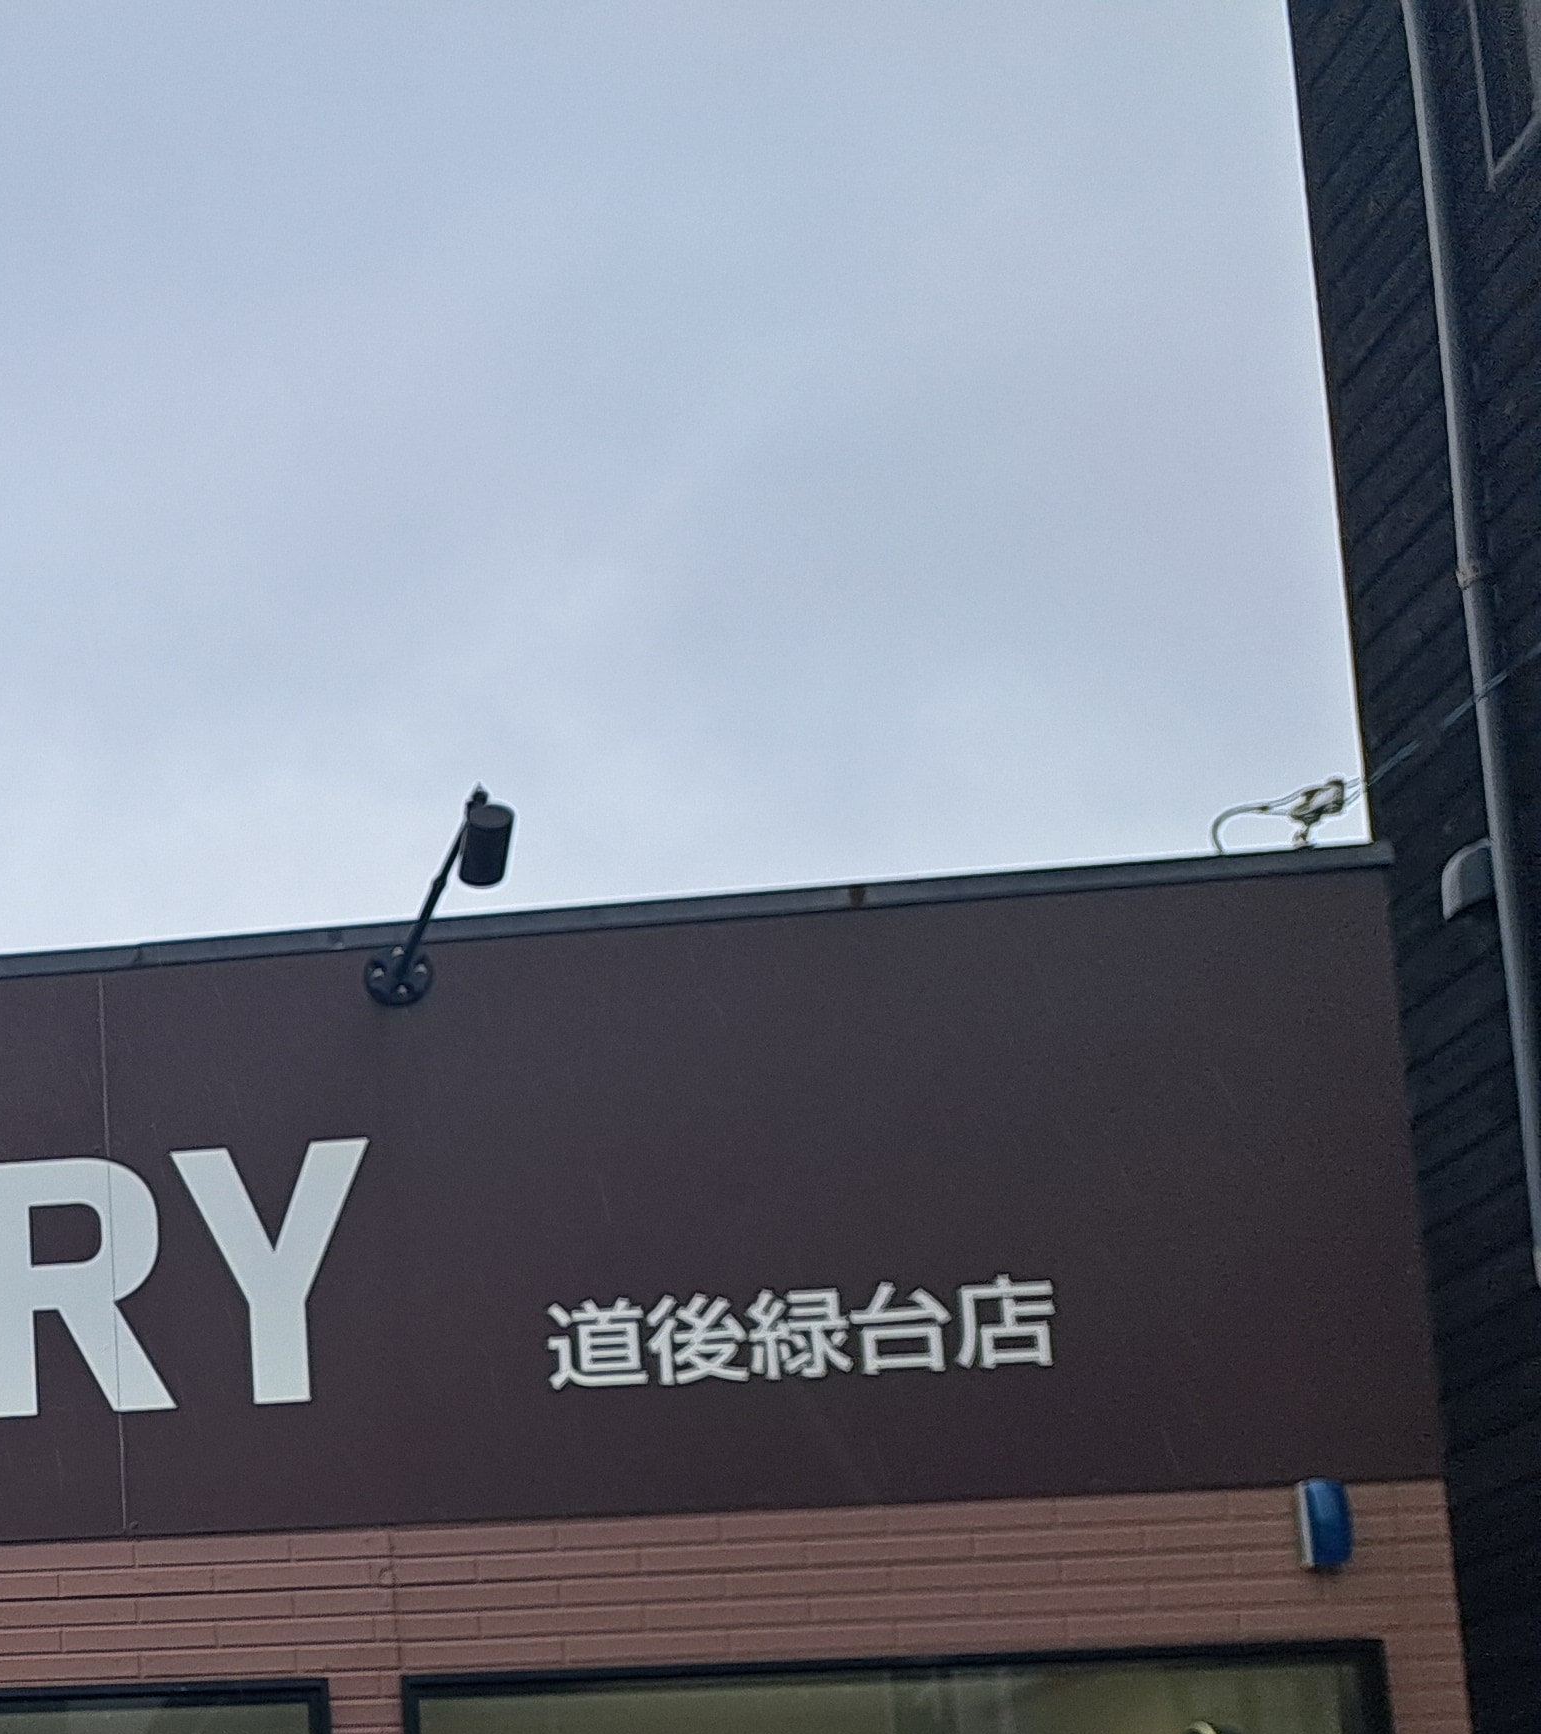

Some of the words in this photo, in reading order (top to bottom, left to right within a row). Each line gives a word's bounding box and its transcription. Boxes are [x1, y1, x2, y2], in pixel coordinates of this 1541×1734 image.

[547, 1277, 1055, 1390] 道後緑台店
